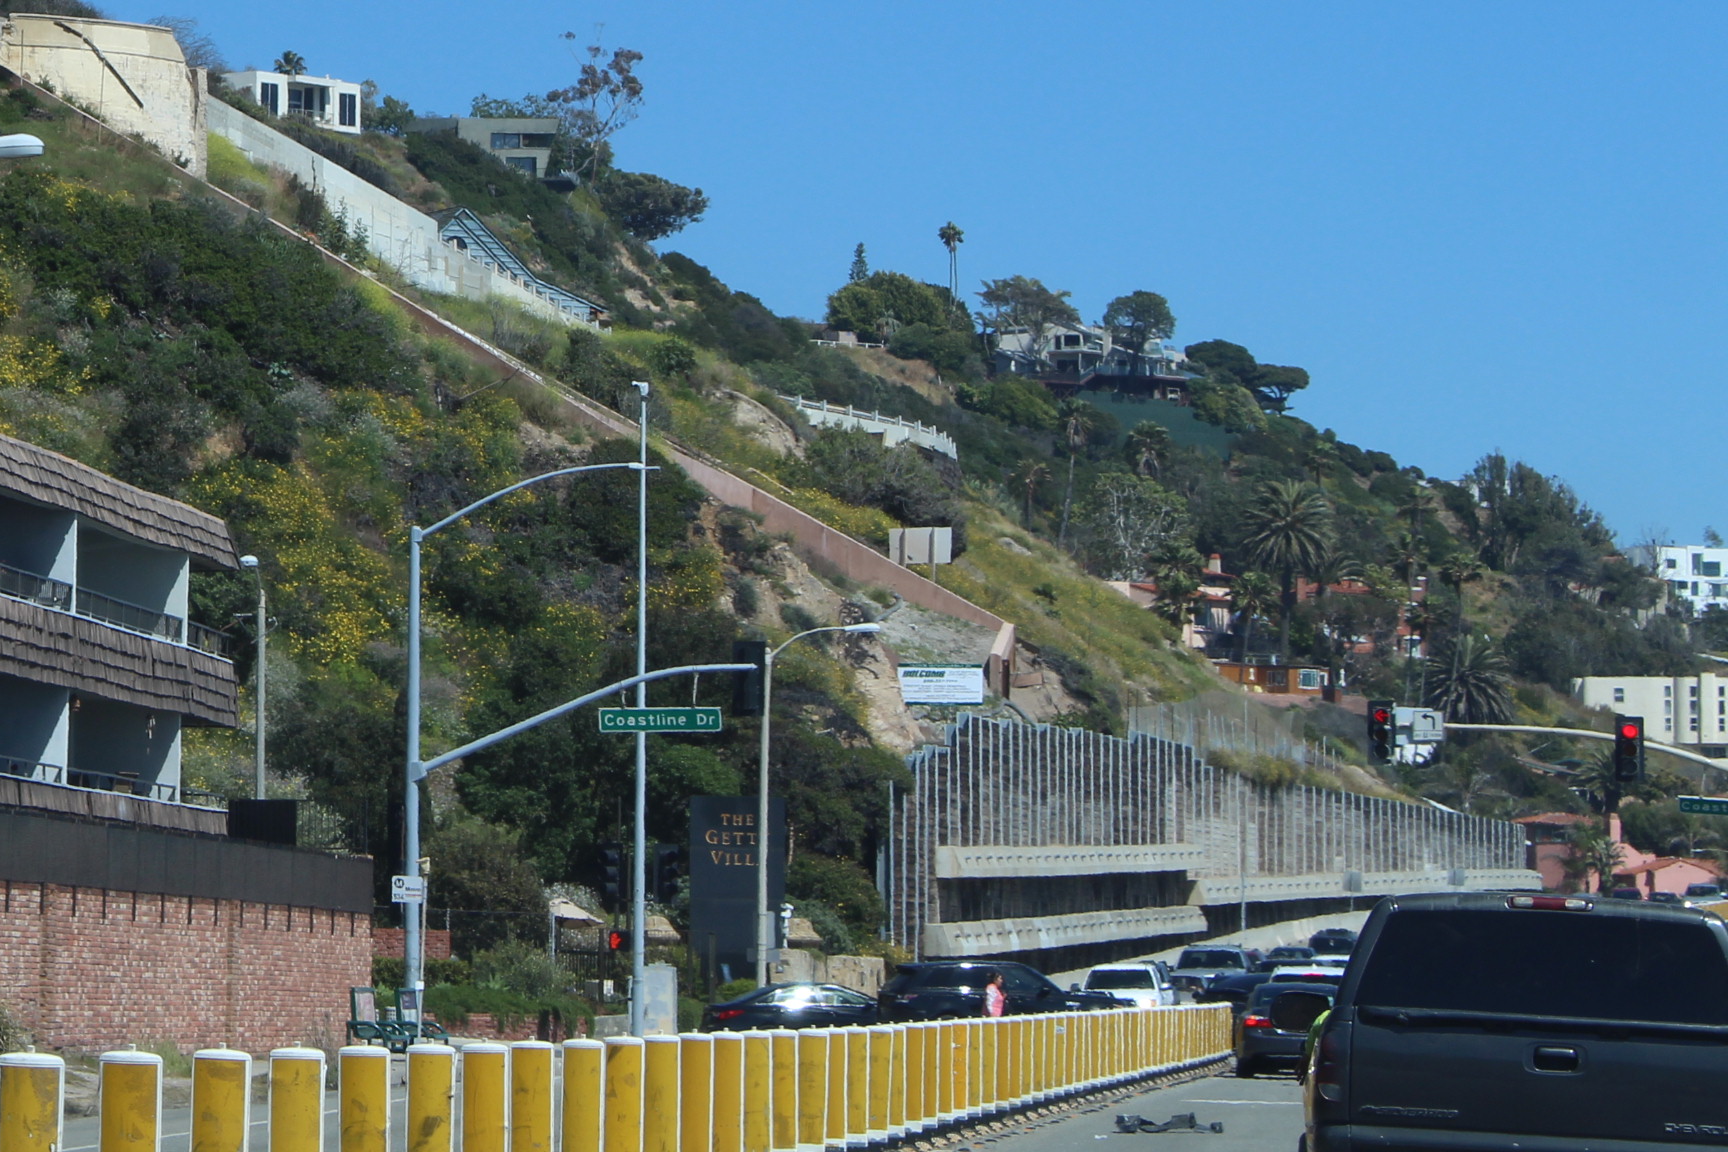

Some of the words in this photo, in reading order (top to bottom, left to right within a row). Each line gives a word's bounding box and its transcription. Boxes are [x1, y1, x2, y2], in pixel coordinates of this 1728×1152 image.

[603, 713, 688, 726] Coastline
[696, 712, 716, 726] Dr
[720, 813, 754, 826] THE
[705, 830, 761, 845] GETT
[711, 850, 760, 866] VILL
